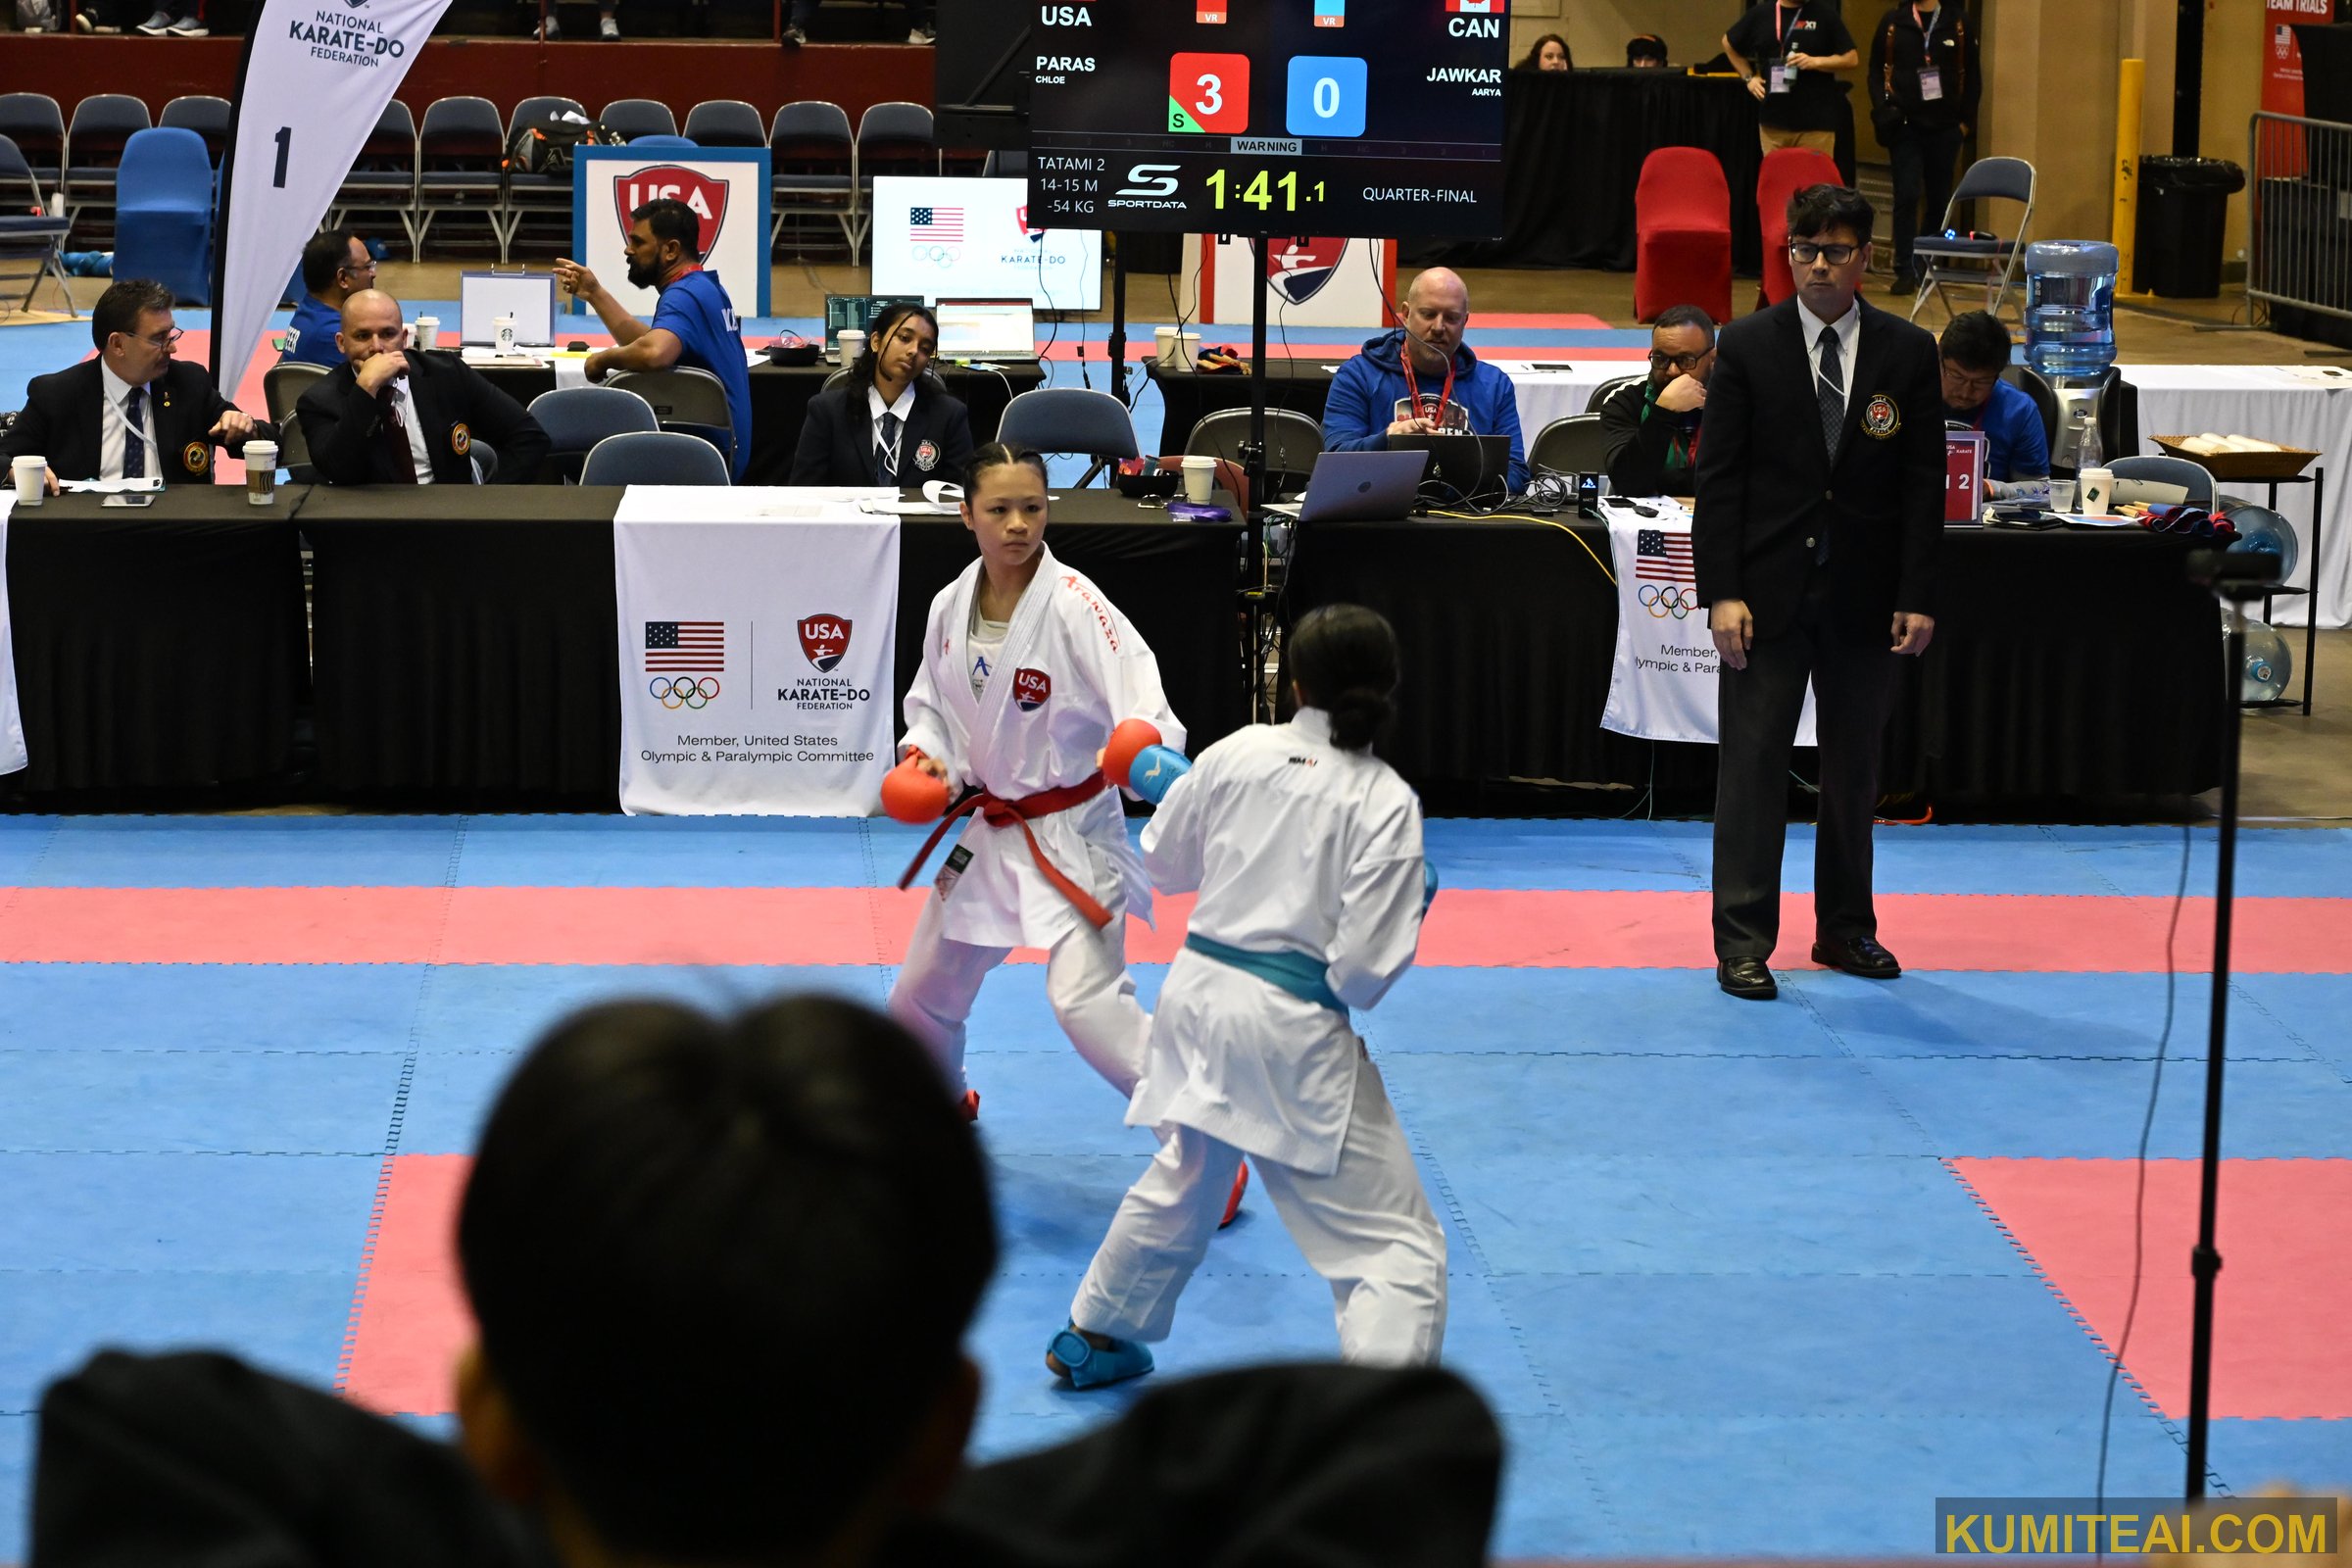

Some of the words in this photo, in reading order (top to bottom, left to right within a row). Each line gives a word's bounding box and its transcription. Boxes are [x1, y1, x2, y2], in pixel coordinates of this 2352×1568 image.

[316, 10, 384, 34] NATIONAL
[1041, 5, 1093, 26] USA
[1204, 13, 1218, 23] VR
[1322, 17, 1336, 26] VR
[1447, 17, 1499, 38] CAN
[289, 20, 405, 59] KARATE-DO
[310, 46, 379, 68] FEDERATION
[1036, 56, 1096, 73] PARAS
[1035, 75, 1065, 84] CHLOE
[1426, 68, 1501, 84] JAWKAR
[1195, 74, 1223, 116] 3
[1313, 76, 1341, 119] 0
[1471, 88, 1501, 97] AARYA
[1172, 113, 1185, 128] S
[1237, 140, 1298, 153] WARNING
[272, 126, 292, 189] 1
[1038, 157, 1092, 171] TATAMI
[1097, 158, 1105, 172] 2
[1041, 178, 1080, 192] 14-15
[1085, 179, 1099, 192] M
[1362, 187, 1478, 204] QUARTER-FINAL
[1047, 199, 1071, 214] -54
[1074, 200, 1095, 214] KG
[1107, 199, 1188, 210] SPORTDATA
[1958, 473, 1970, 490] 2
[805, 623, 845, 640] USA
[1660, 644, 1718, 660] Member,
[1635, 656, 1679, 671] lympic
[1682, 662, 1692, 673] &
[797, 678, 853, 687] NATIONAL
[1018, 671, 1048, 694] USA
[777, 688, 870, 701] KARATE-DO
[797, 702, 853, 710] FEDERATION
[677, 735, 740, 748] Member,
[744, 735, 790, 746] United
[793, 734, 839, 747] States
[641, 750, 698, 764] Olympic
[701, 751, 712, 762] &
[715, 751, 794, 764] Paralympic
[797, 751, 875, 762] Committee
